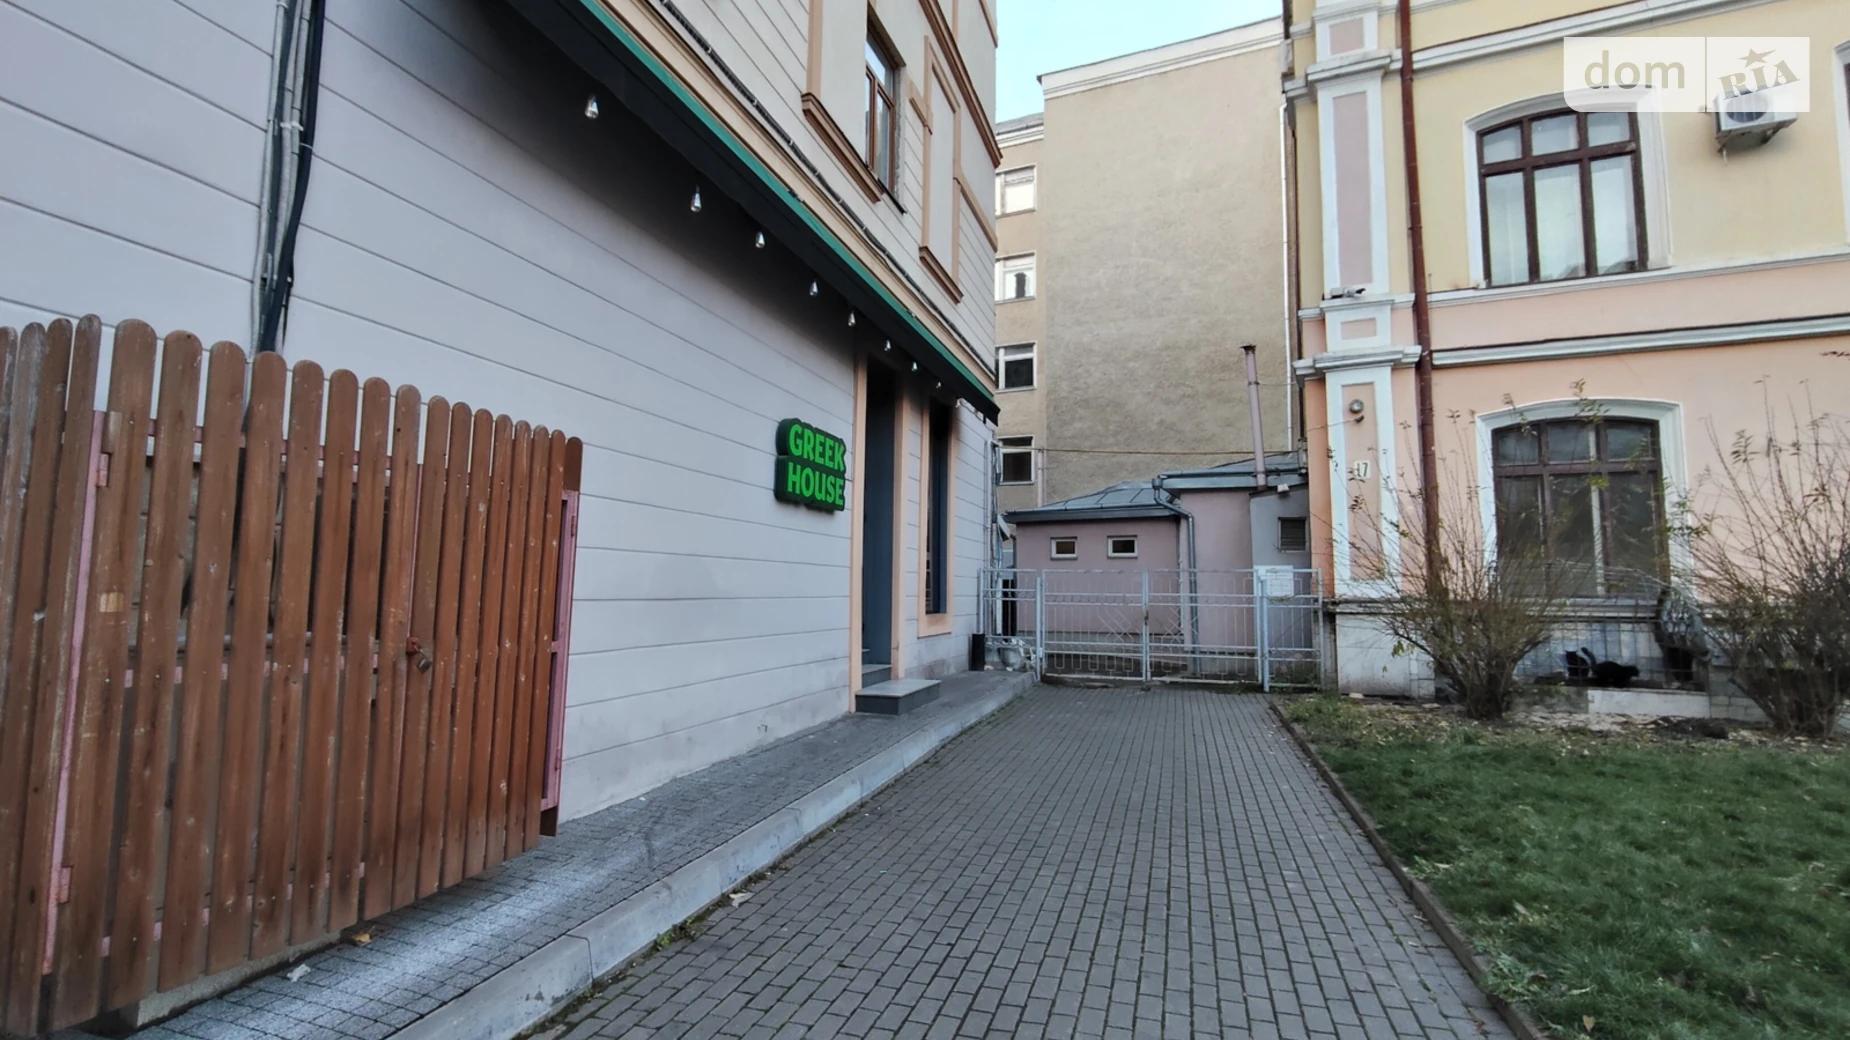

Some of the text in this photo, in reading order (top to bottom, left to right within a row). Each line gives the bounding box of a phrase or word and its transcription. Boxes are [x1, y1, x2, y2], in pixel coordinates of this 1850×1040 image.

[789, 424, 845, 472] GREEK
[1356, 462, 1369, 477] 17
[787, 461, 844, 506] HOUSE
